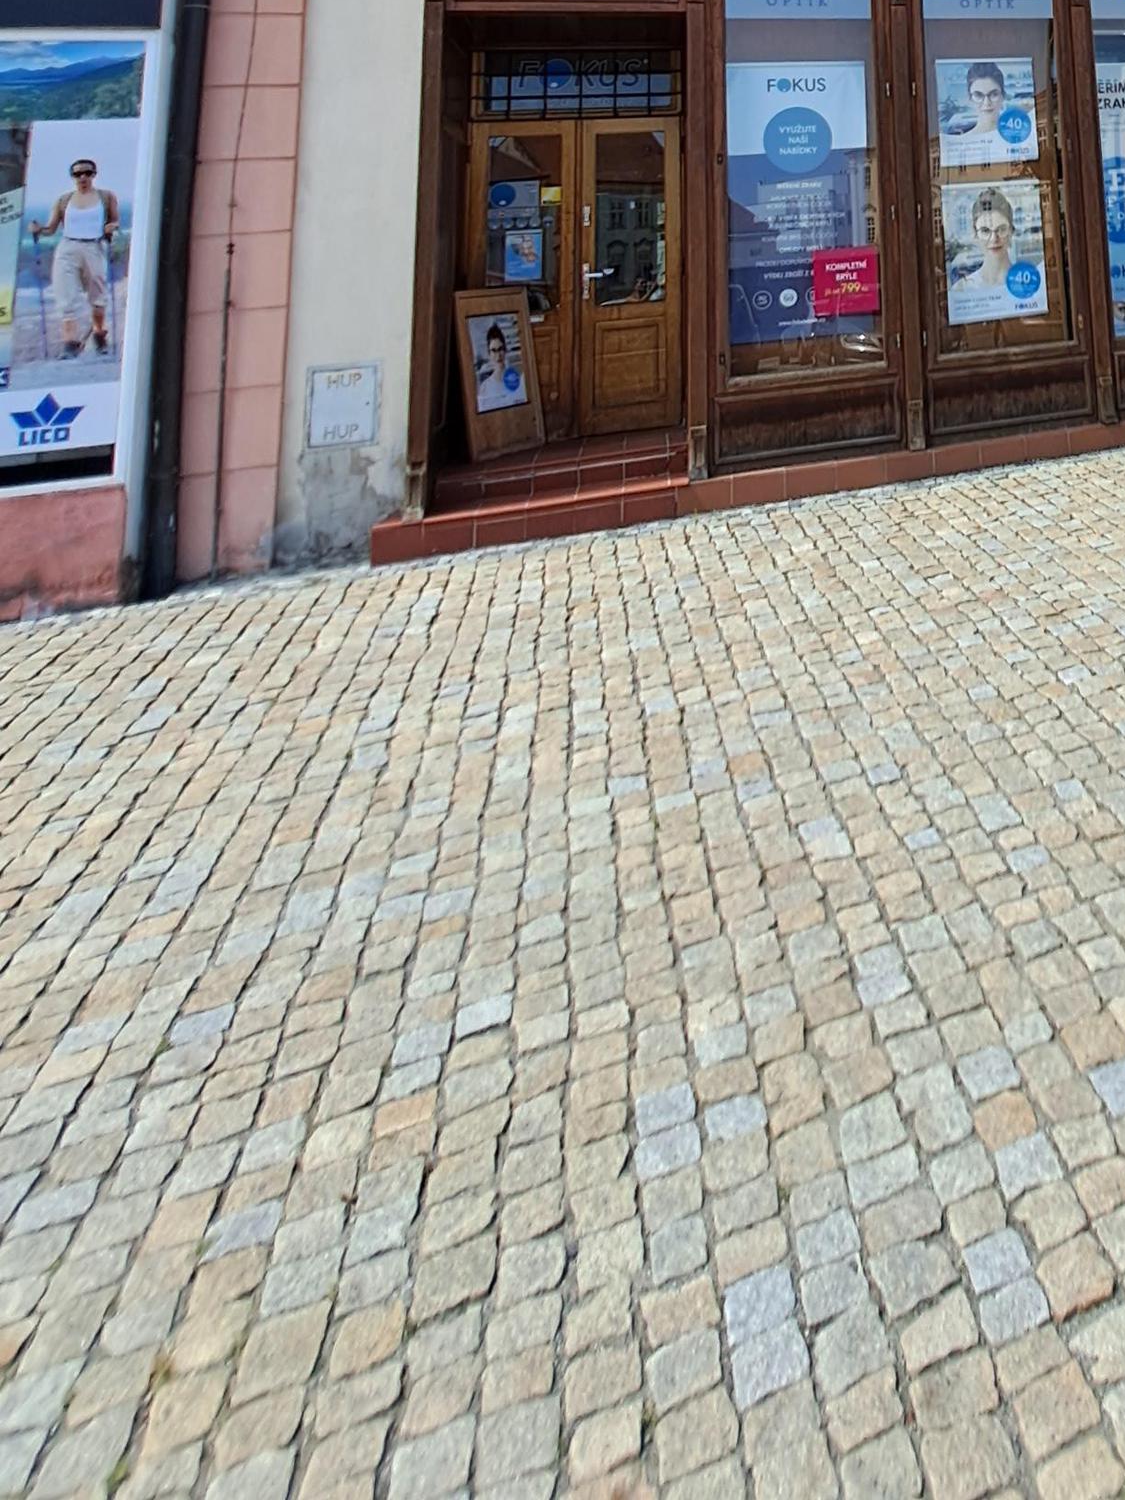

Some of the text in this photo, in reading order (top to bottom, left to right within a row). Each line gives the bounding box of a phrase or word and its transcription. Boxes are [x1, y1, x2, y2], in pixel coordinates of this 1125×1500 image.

[767, 77, 827, 93] FOKUS
[779, 146, 818, 155] NABÍDKY
[825, 260, 867, 272] KOMPLETNÍ
[835, 271, 858, 281] BRÝLE
[841, 281, 861, 294] 799
[326, 372, 362, 389] HUP
[18, 426, 70, 447] LICO
[322, 423, 359, 440] HUP
